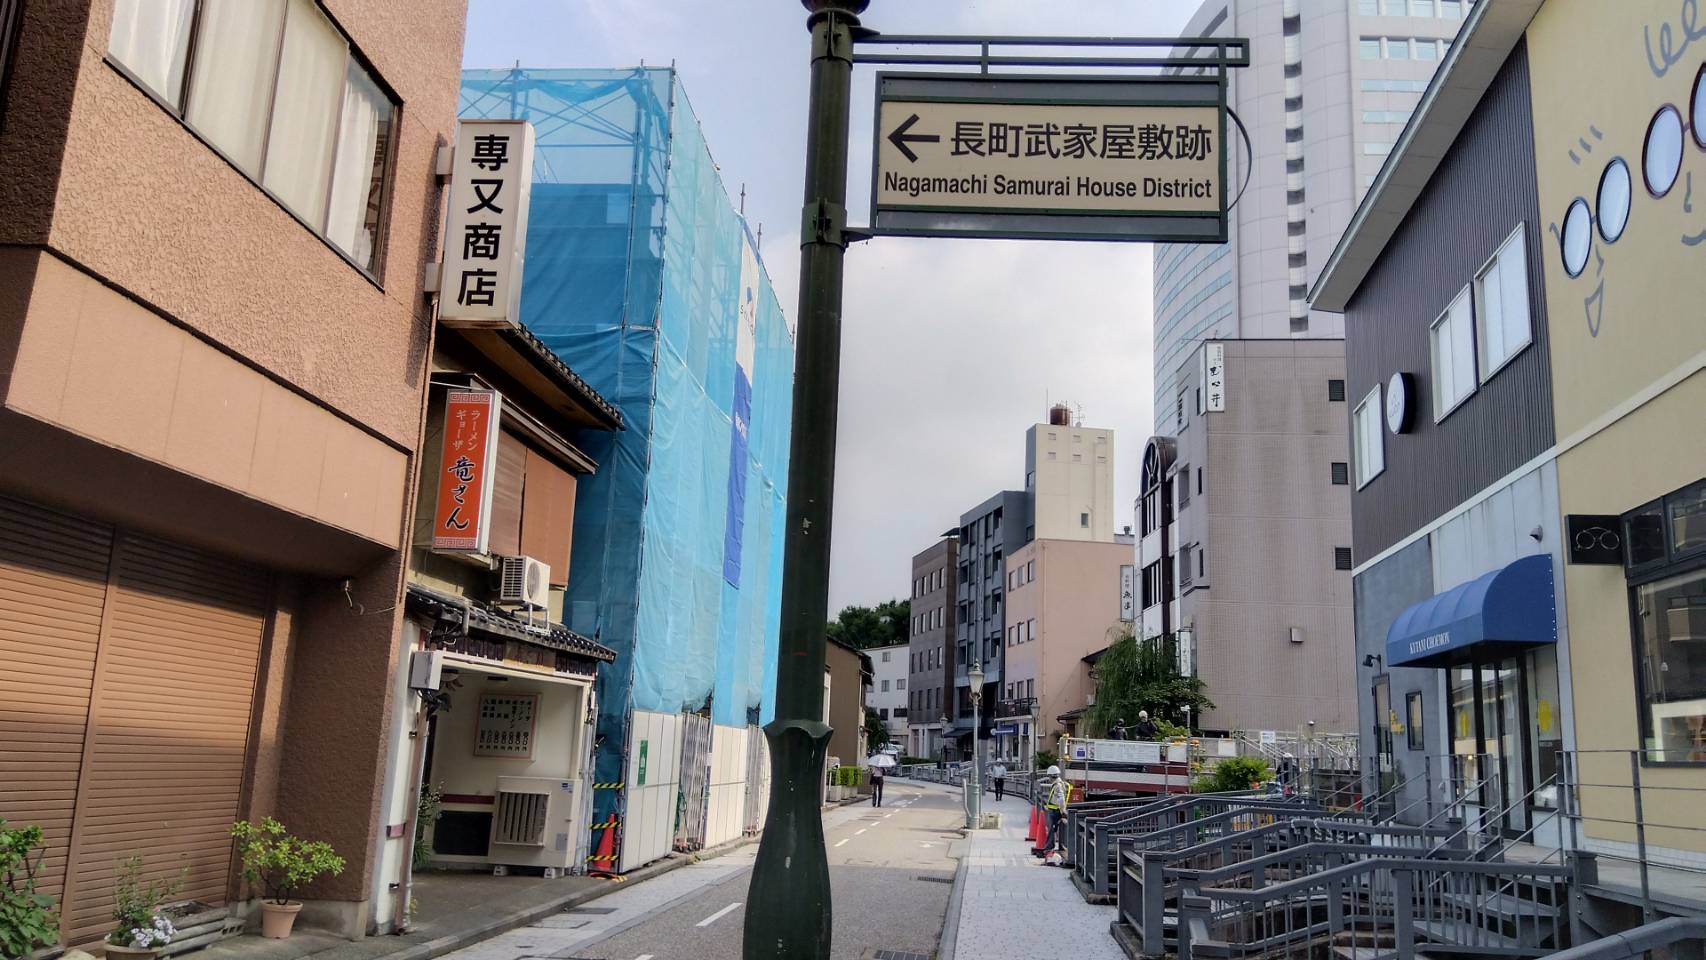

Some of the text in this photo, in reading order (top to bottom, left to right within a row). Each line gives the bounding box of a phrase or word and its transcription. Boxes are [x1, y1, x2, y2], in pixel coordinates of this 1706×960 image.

[950, 121, 1212, 161] 長町武家屋敷跡
[884, 171, 1212, 198] Nagamachi Samurai House District
[457, 134, 510, 307] 専又商店
[452, 409, 467, 451] ギョーザ
[467, 410, 481, 451] ラーメン
[445, 456, 475, 531] 竜さん
